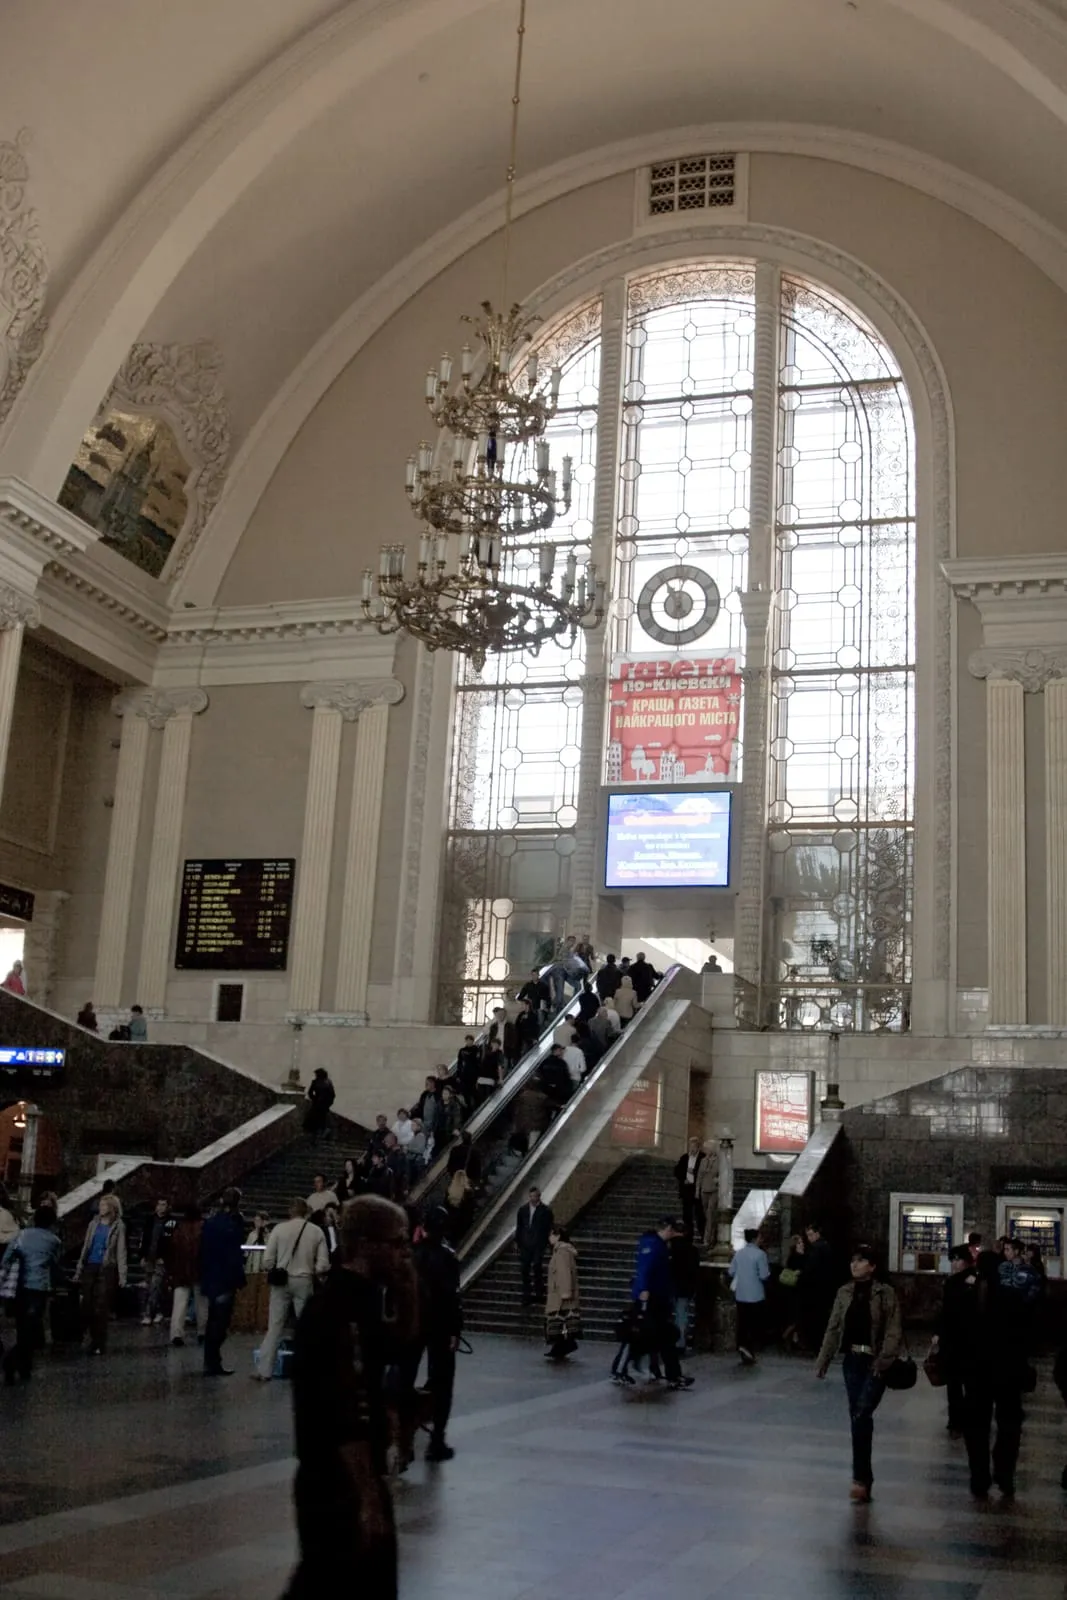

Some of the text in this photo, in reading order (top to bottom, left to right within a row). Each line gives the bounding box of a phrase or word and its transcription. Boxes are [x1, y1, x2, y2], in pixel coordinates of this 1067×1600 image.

[632, 695, 720, 711] КРАЩА ГАЗЕТА
[615, 711, 737, 728] НАЙКРАЩОГО МІСТА
